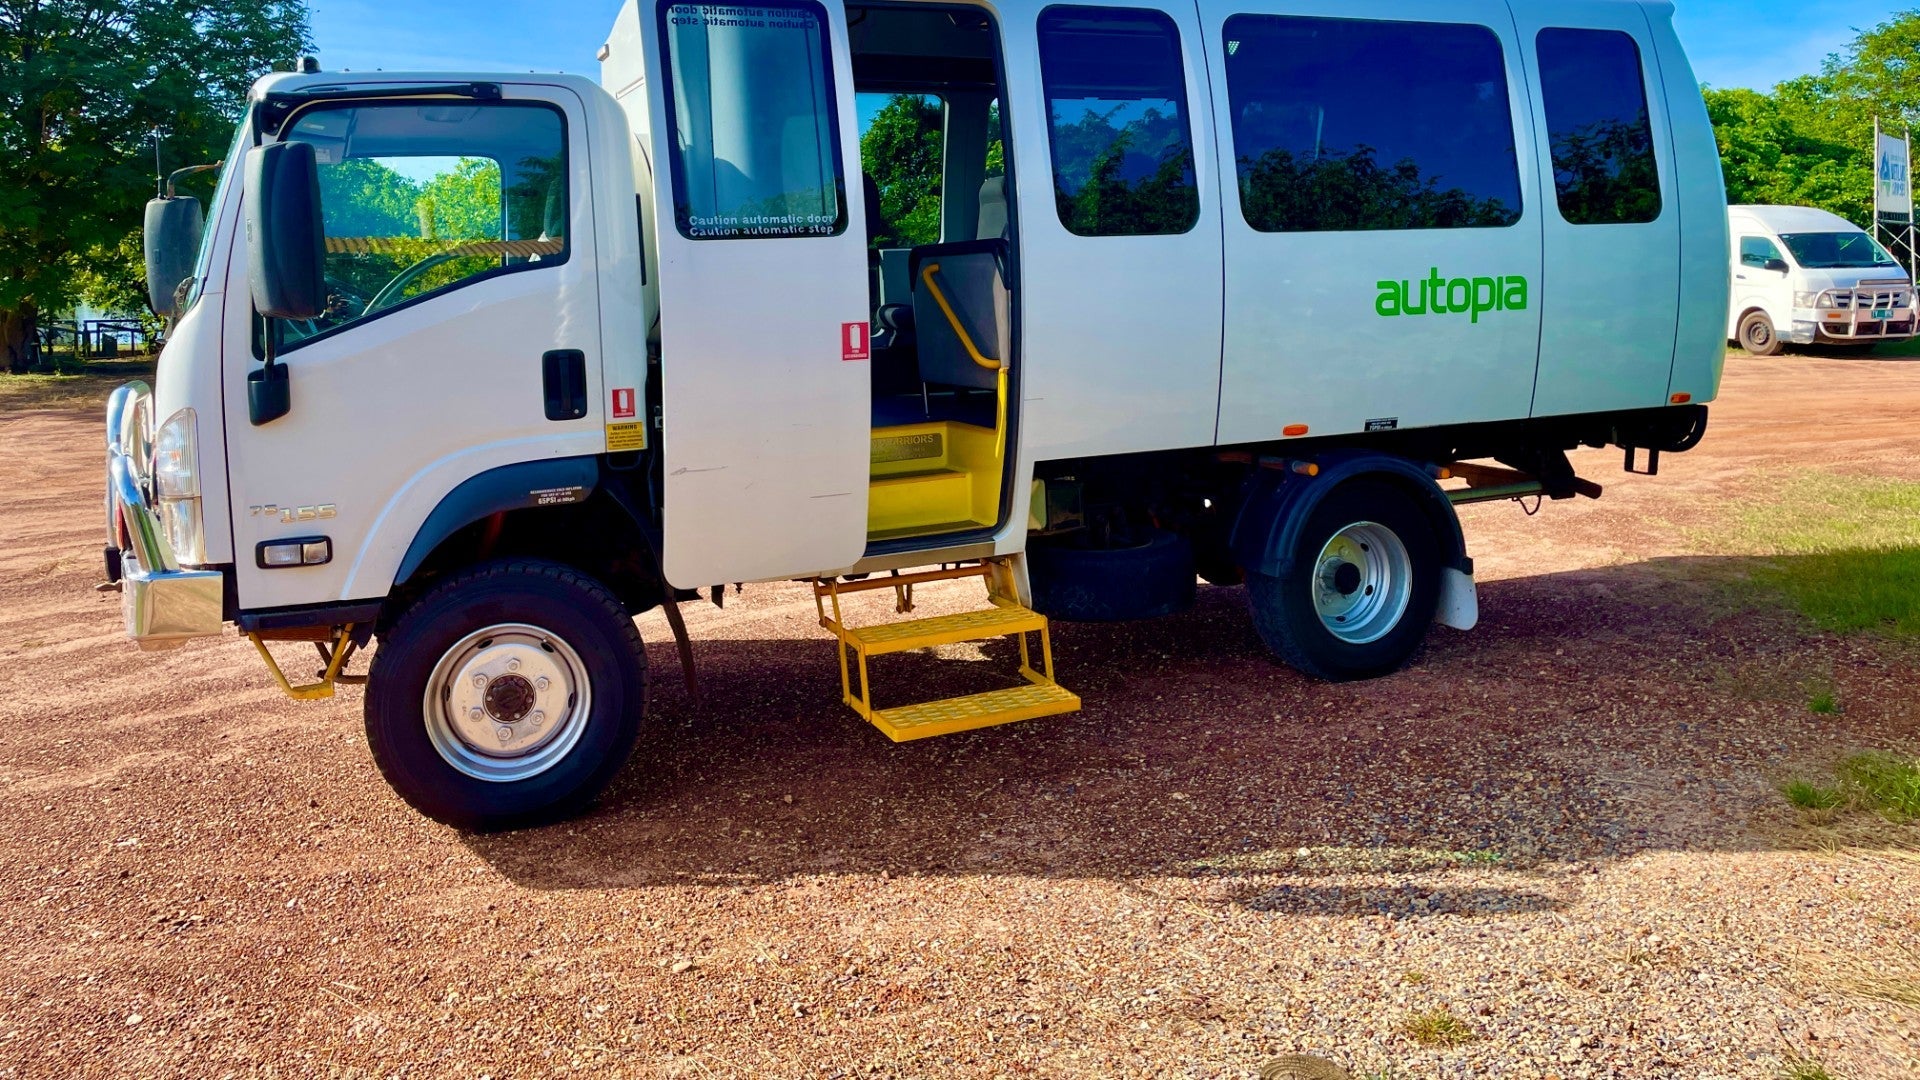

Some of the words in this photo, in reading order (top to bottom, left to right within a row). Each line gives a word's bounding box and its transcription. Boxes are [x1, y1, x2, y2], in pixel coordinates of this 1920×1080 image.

[689, 215, 738, 226] Caution
[742, 213, 805, 224] automatic
[807, 213, 834, 223] door
[689, 226, 739, 236] Caution
[743, 225, 805, 235] automatic
[808, 225, 834, 235] step
[1375, 267, 1528, 323] autopia
